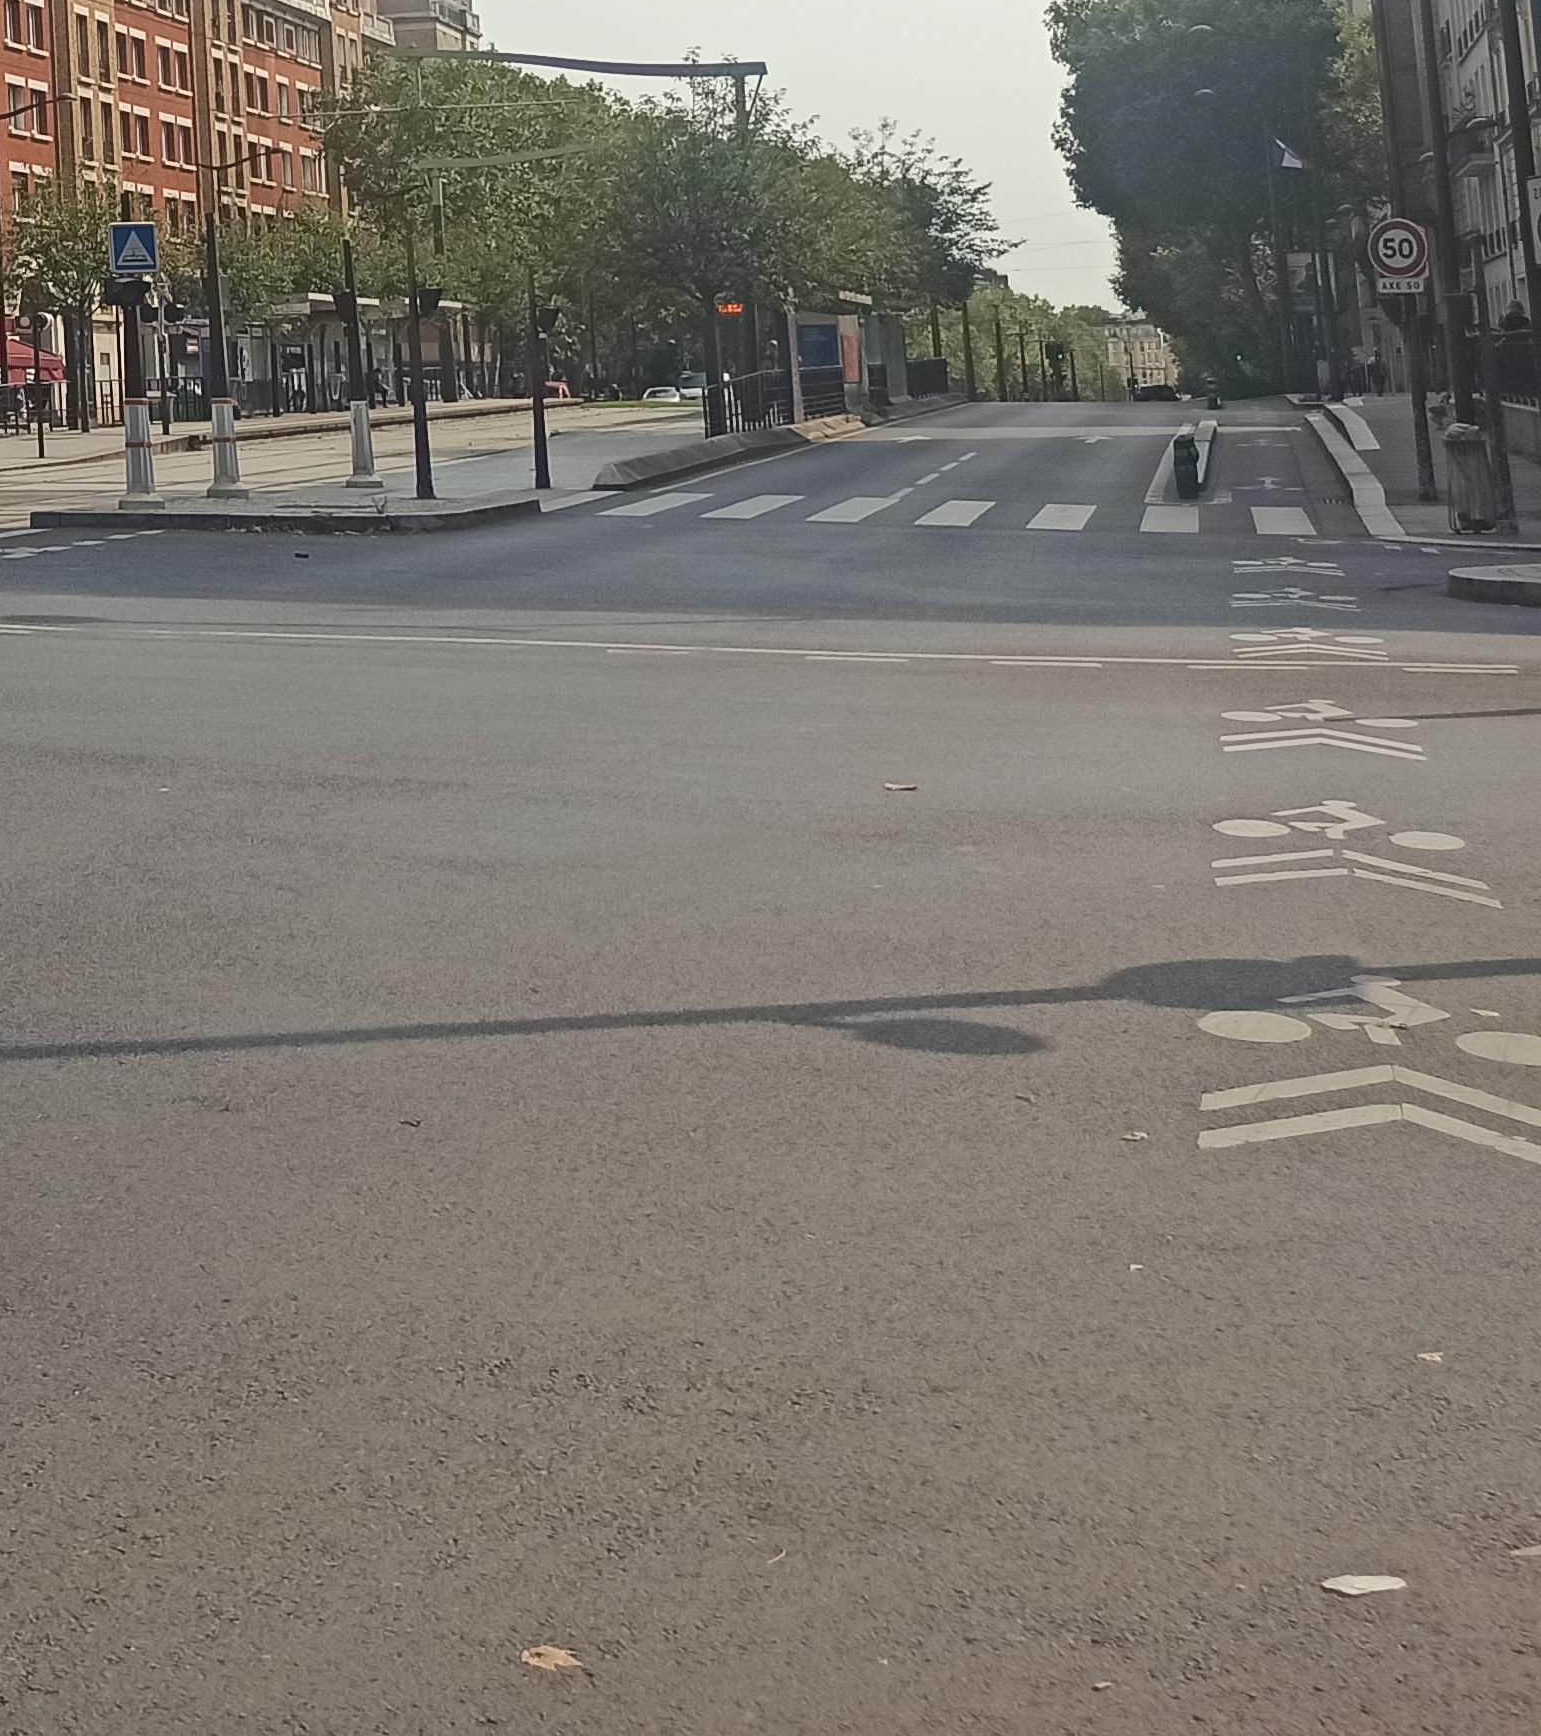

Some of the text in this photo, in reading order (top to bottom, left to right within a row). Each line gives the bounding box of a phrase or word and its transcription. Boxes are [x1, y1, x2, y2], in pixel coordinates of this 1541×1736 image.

[1382, 237, 1414, 259] 50
[1381, 281, 1420, 290] AXE 50
